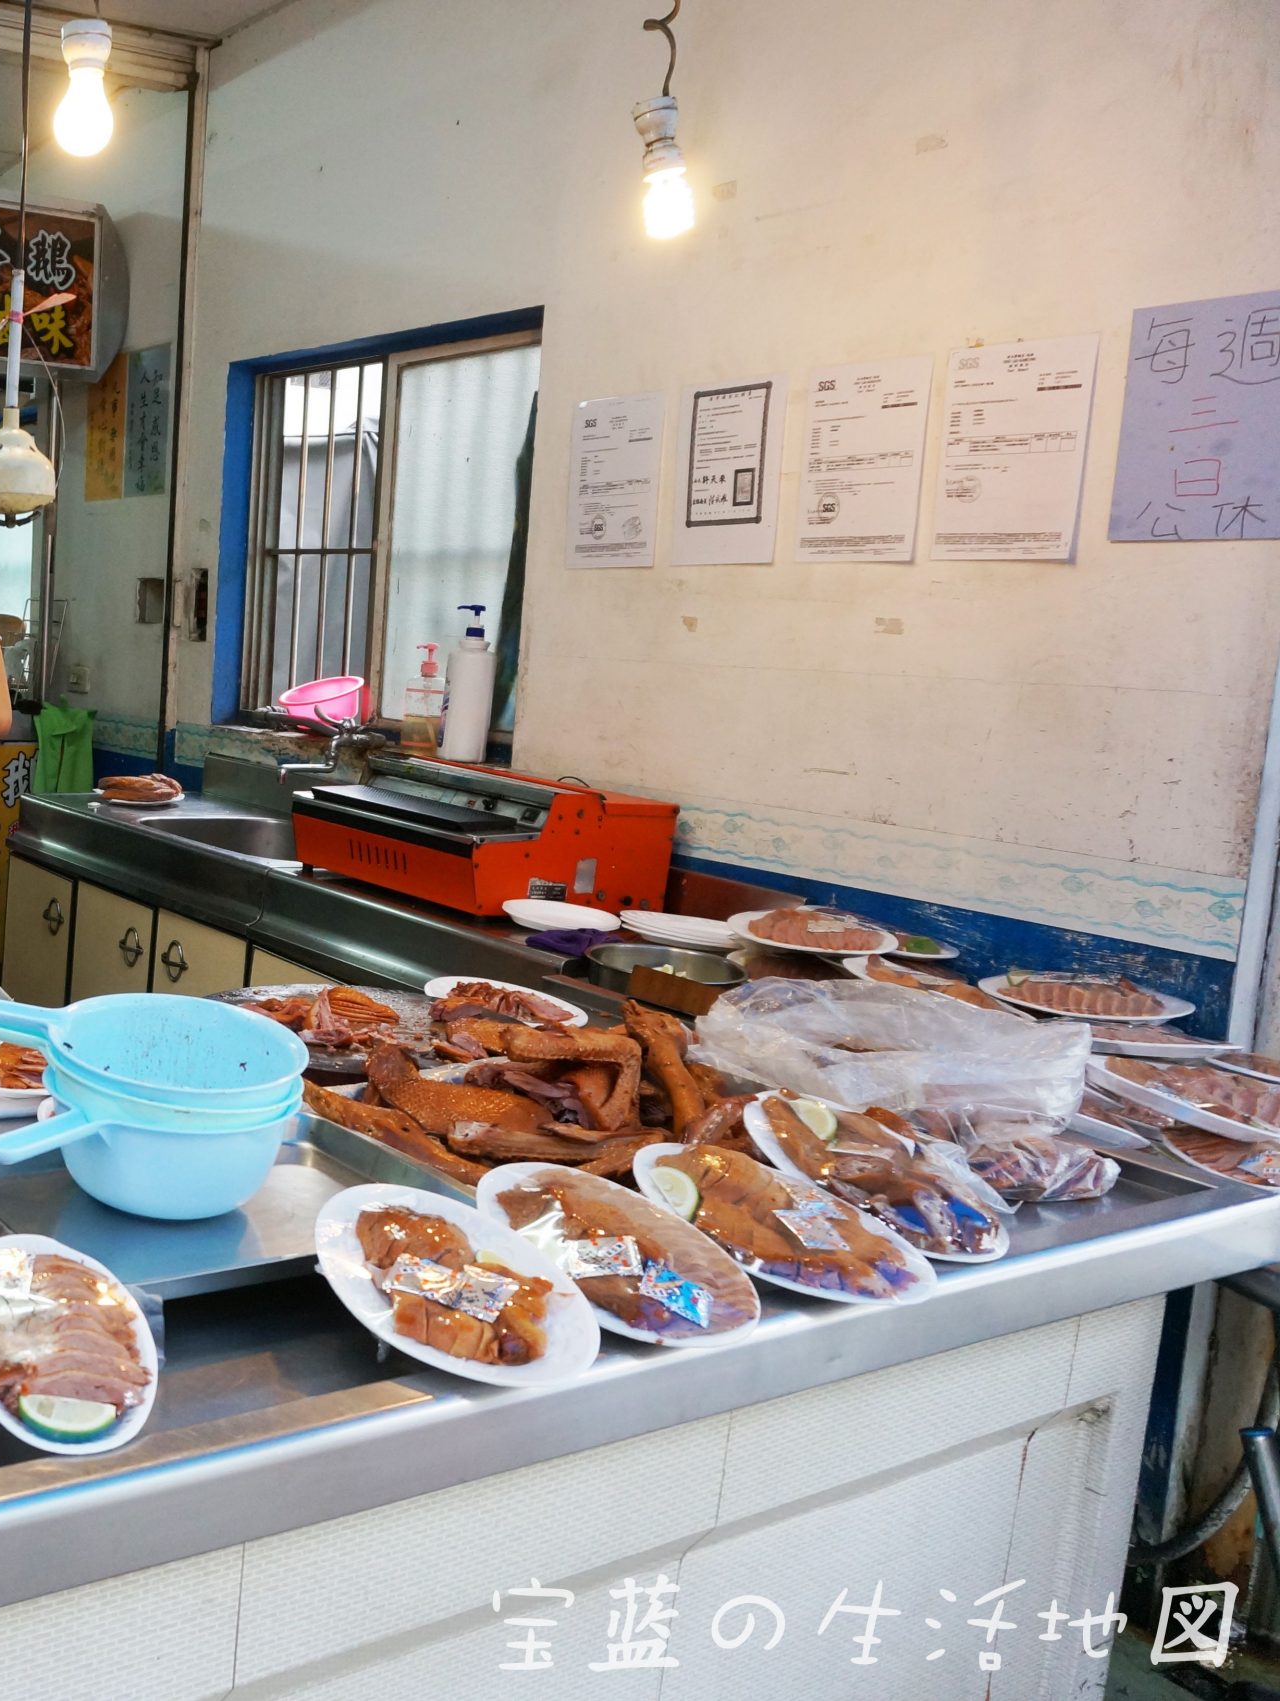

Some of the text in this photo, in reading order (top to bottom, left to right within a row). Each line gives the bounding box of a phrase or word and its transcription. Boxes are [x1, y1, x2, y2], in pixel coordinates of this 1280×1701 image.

[1134, 307, 1280, 386] 每週
[818, 380, 836, 391] SGS
[584, 419, 598, 428] SGS
[1168, 396, 1239, 433] 三
[1175, 459, 1221, 497] 日
[822, 503, 835, 512] SGS
[1136, 496, 1267, 540] 公休
